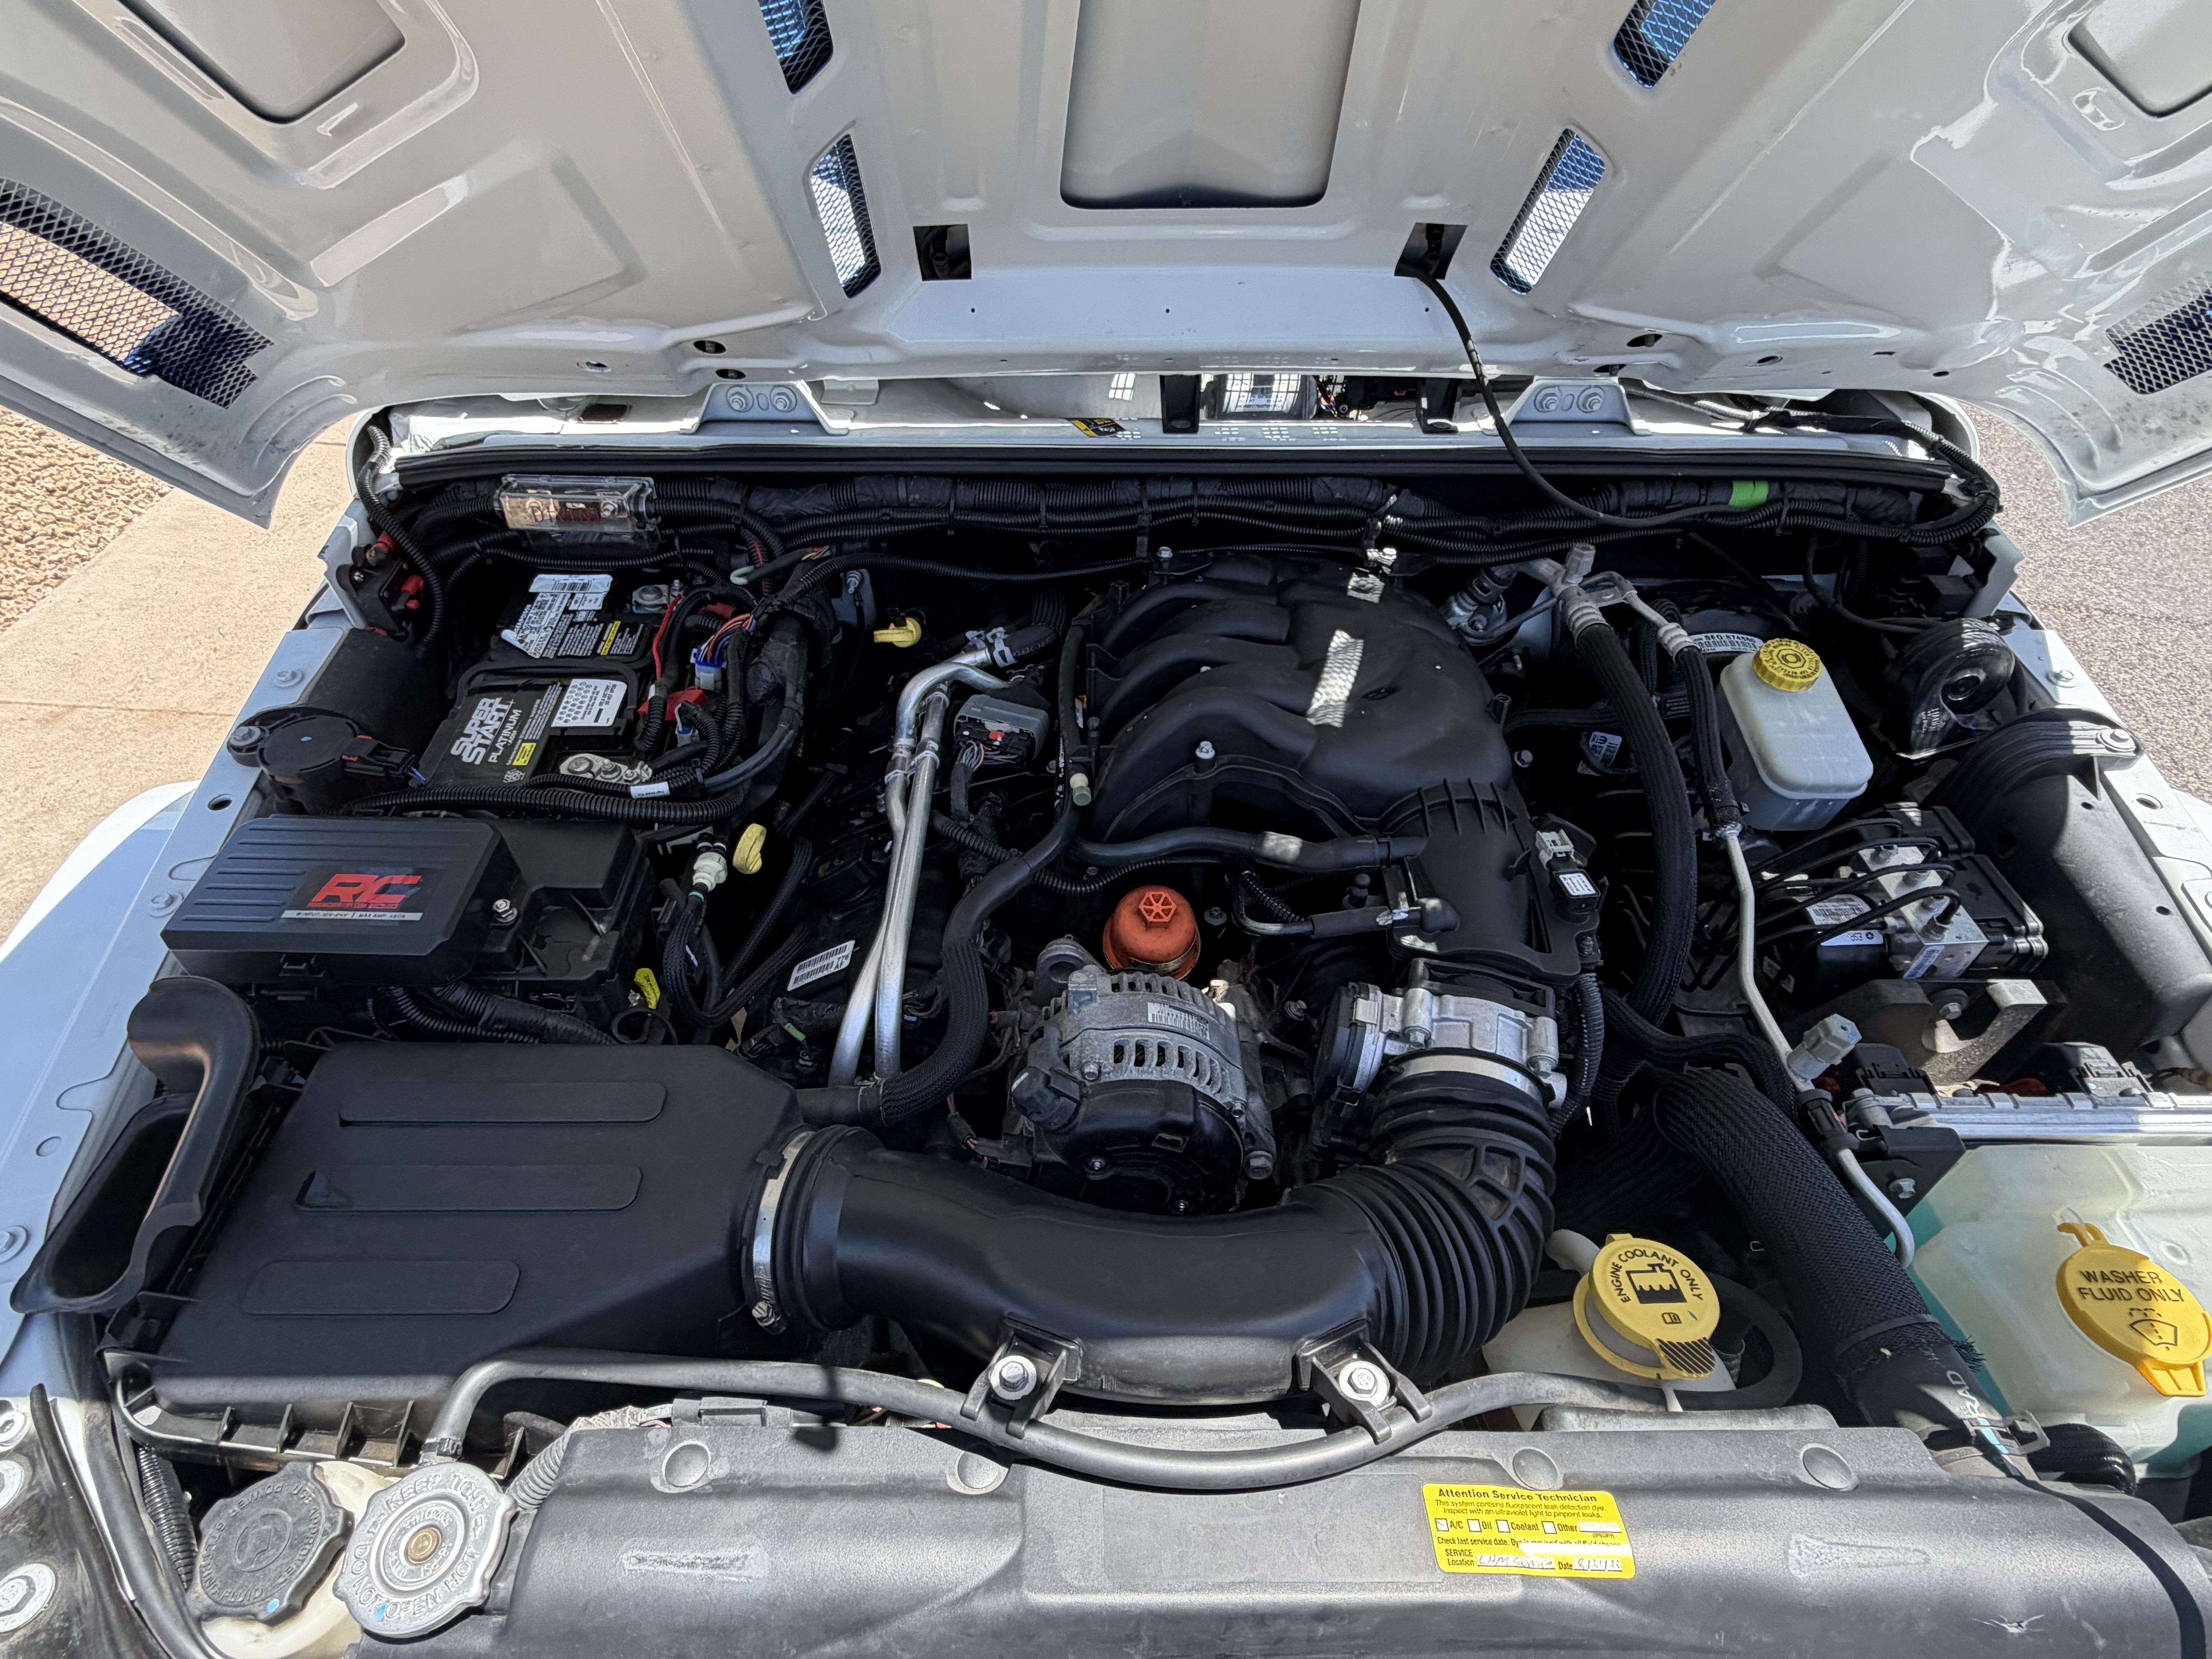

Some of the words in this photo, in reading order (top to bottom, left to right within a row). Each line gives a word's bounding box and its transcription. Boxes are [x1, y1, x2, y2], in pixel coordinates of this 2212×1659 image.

[450, 698, 496, 755] SUPER
[462, 697, 510, 765] START
[488, 709, 522, 763] PLATINUM
[311, 874, 422, 903] RC
[834, 960, 845, 970] AF
[836, 954, 850, 962] 776
[1618, 1249, 1679, 1267] COOLANT
[1609, 1261, 1631, 1303] ENGINE
[1680, 1269, 1704, 1300] ONLY
[2081, 1269, 2164, 1285] WASHER
[2077, 1286, 2133, 1301] FLUID
[2136, 1288, 2185, 1303] ONLY
[1946, 1370, 1985, 1419] RAD
[230, 1480, 285, 1518] POWER
[390, 1474, 442, 1511] KEEP
[451, 1472, 492, 1513] TIGHT
[1438, 1488, 1489, 1499] Attention
[1493, 1490, 1533, 1501] Service
[1537, 1492, 1597, 1503] Technician
[1451, 1501, 1475, 1509] system
[1444, 1507, 1470, 1515] Inspect
[1529, 1510, 1543, 1518] light
[1450, 1521, 1463, 1529] A/C
[1482, 1522, 1492, 1530] Oil
[1511, 1522, 1539, 1531] Coolant
[1558, 1523, 1577, 1532] Other
[1437, 1537, 1456, 1545] Check
[1458, 1537, 1469, 1546] last
[199, 1522, 227, 1594] STEERING
[350, 1542, 373, 1576] DO
[445, 1546, 480, 1592] HOT
[1448, 1558, 1475, 1566] Location
[1558, 1562, 1573, 1570] Date
[220, 1587, 263, 1602] FLUID
[356, 1573, 386, 1612] NOT
[385, 1590, 442, 1620] OPEN
